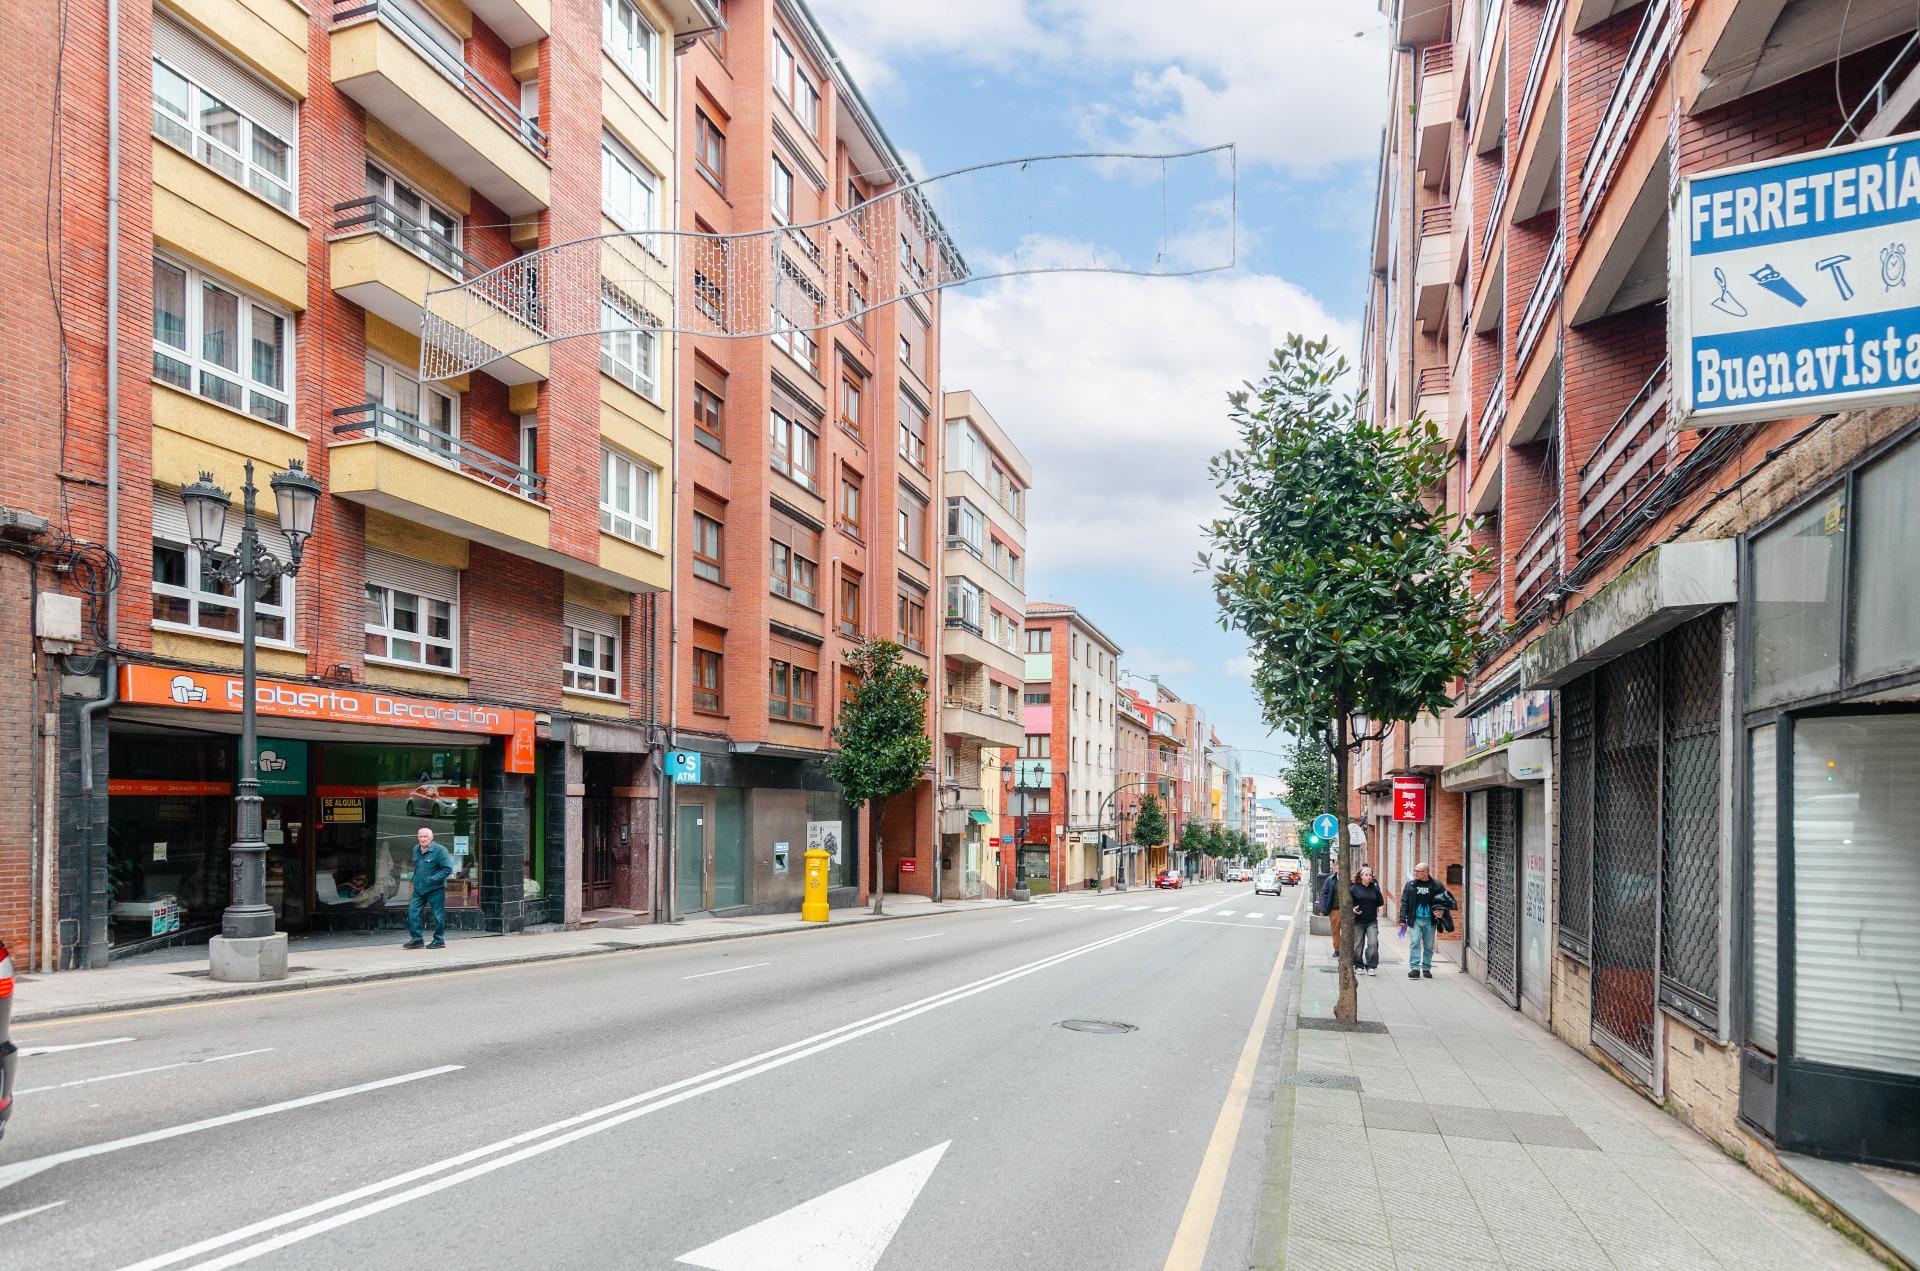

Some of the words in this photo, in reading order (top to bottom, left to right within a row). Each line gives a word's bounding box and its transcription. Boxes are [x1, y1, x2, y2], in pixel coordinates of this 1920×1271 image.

[1692, 148, 1920, 242] FERRETERÍA
[1697, 326, 1920, 403] Buenavista
[226, 680, 359, 712] Roberto
[374, 697, 499, 725] Decoración
[677, 772, 697, 782] ATM
[685, 755, 697, 771] S
[324, 799, 333, 807] SE
[334, 799, 362, 807] ALQUILA
